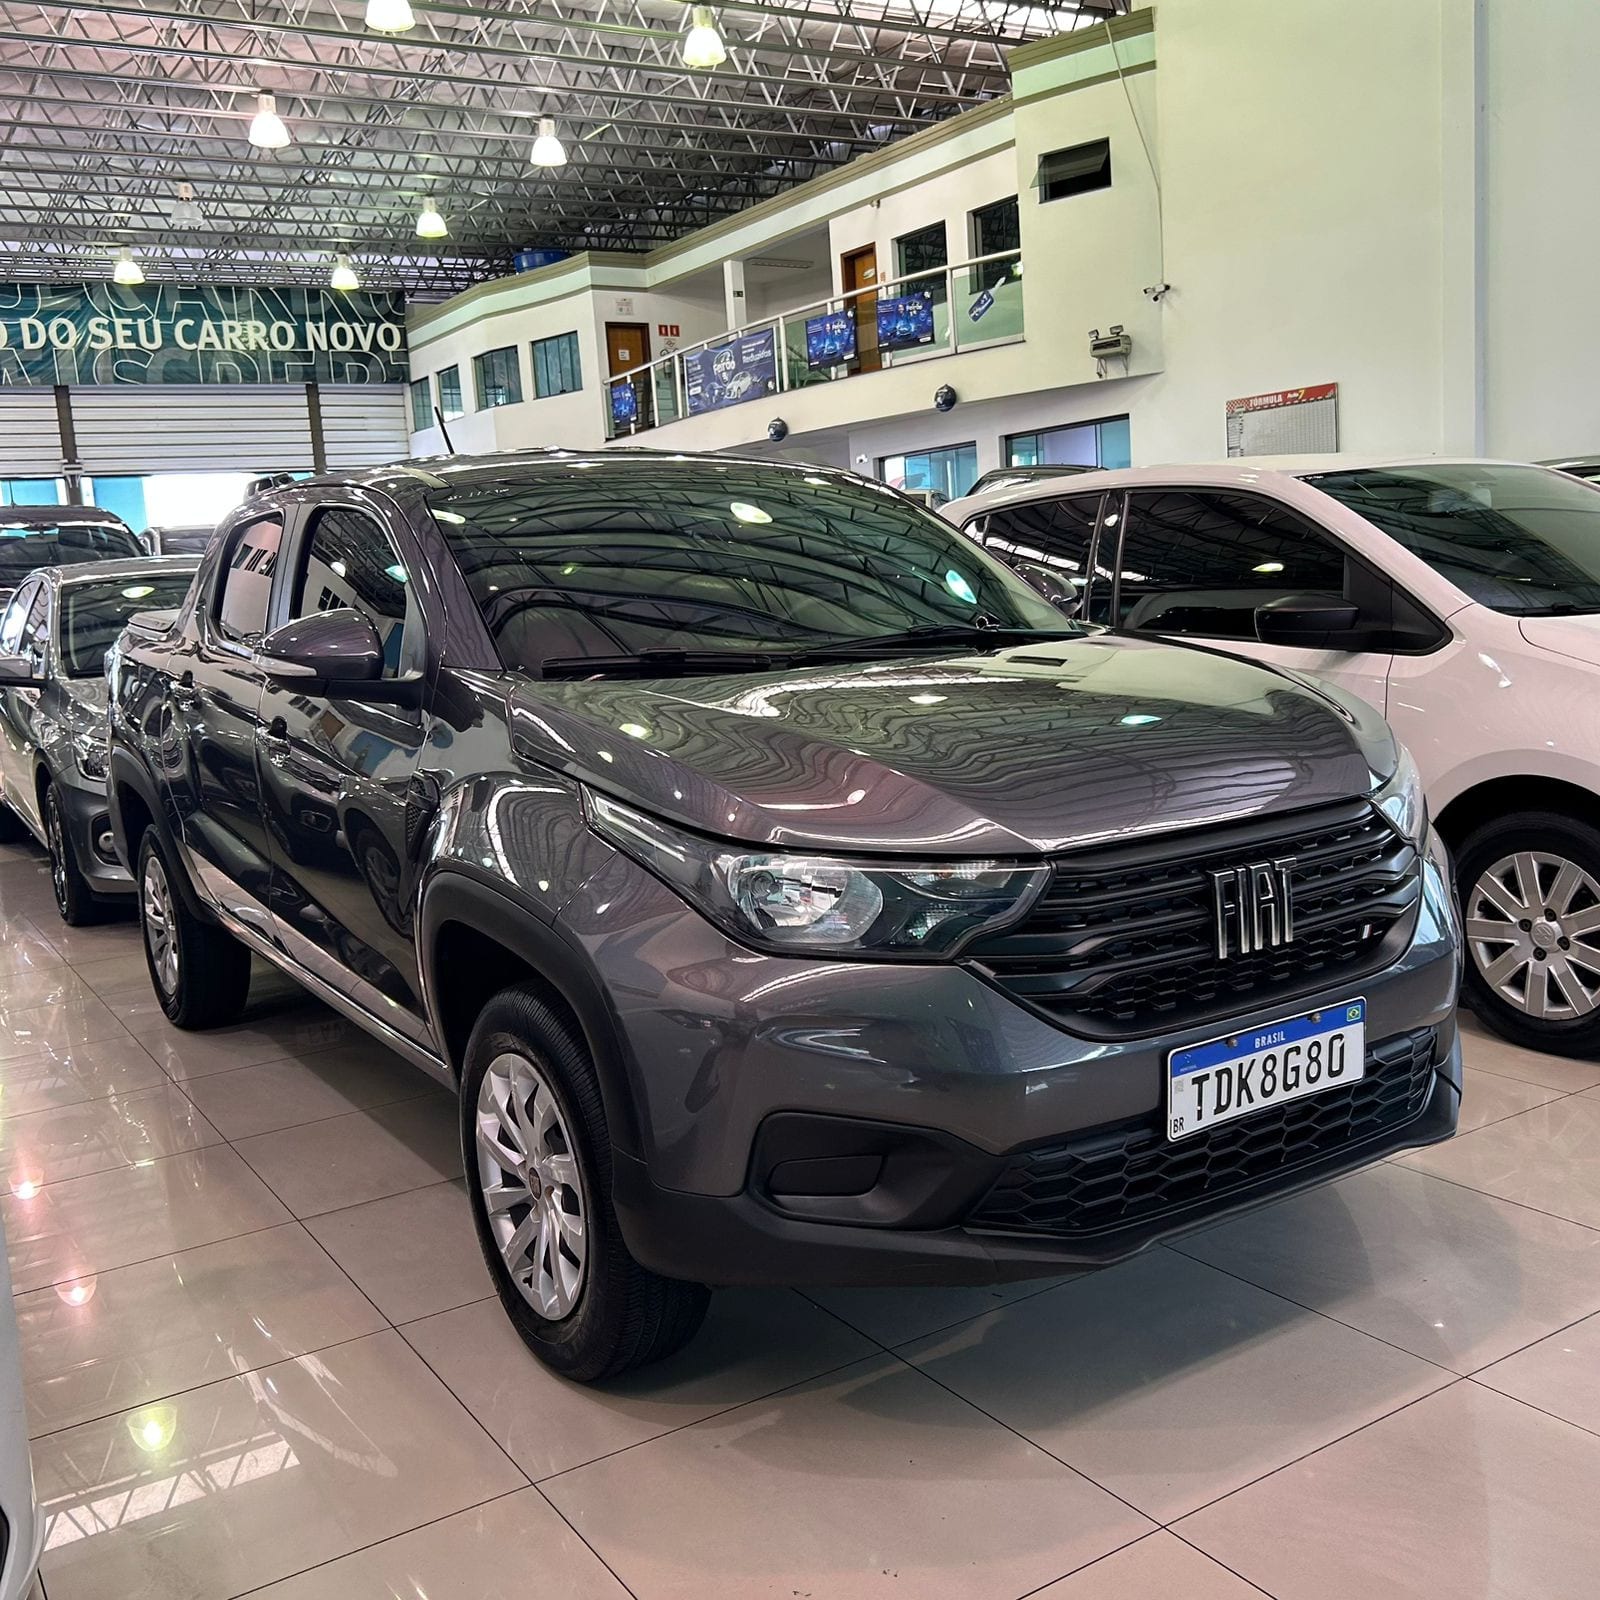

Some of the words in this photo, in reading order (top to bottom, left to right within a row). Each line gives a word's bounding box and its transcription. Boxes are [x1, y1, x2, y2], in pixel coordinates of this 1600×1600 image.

[20, 317, 78, 350] DO
[88, 317, 163, 350] SEU
[174, 319, 296, 351] CARRO
[305, 321, 402, 351] NOVO
[1212, 855, 1297, 960] FIAT
[1254, 1030, 1286, 1049] BRASIL
[1191, 1033, 1346, 1122] TDK8G80
[1173, 1116, 1185, 1133] BR
